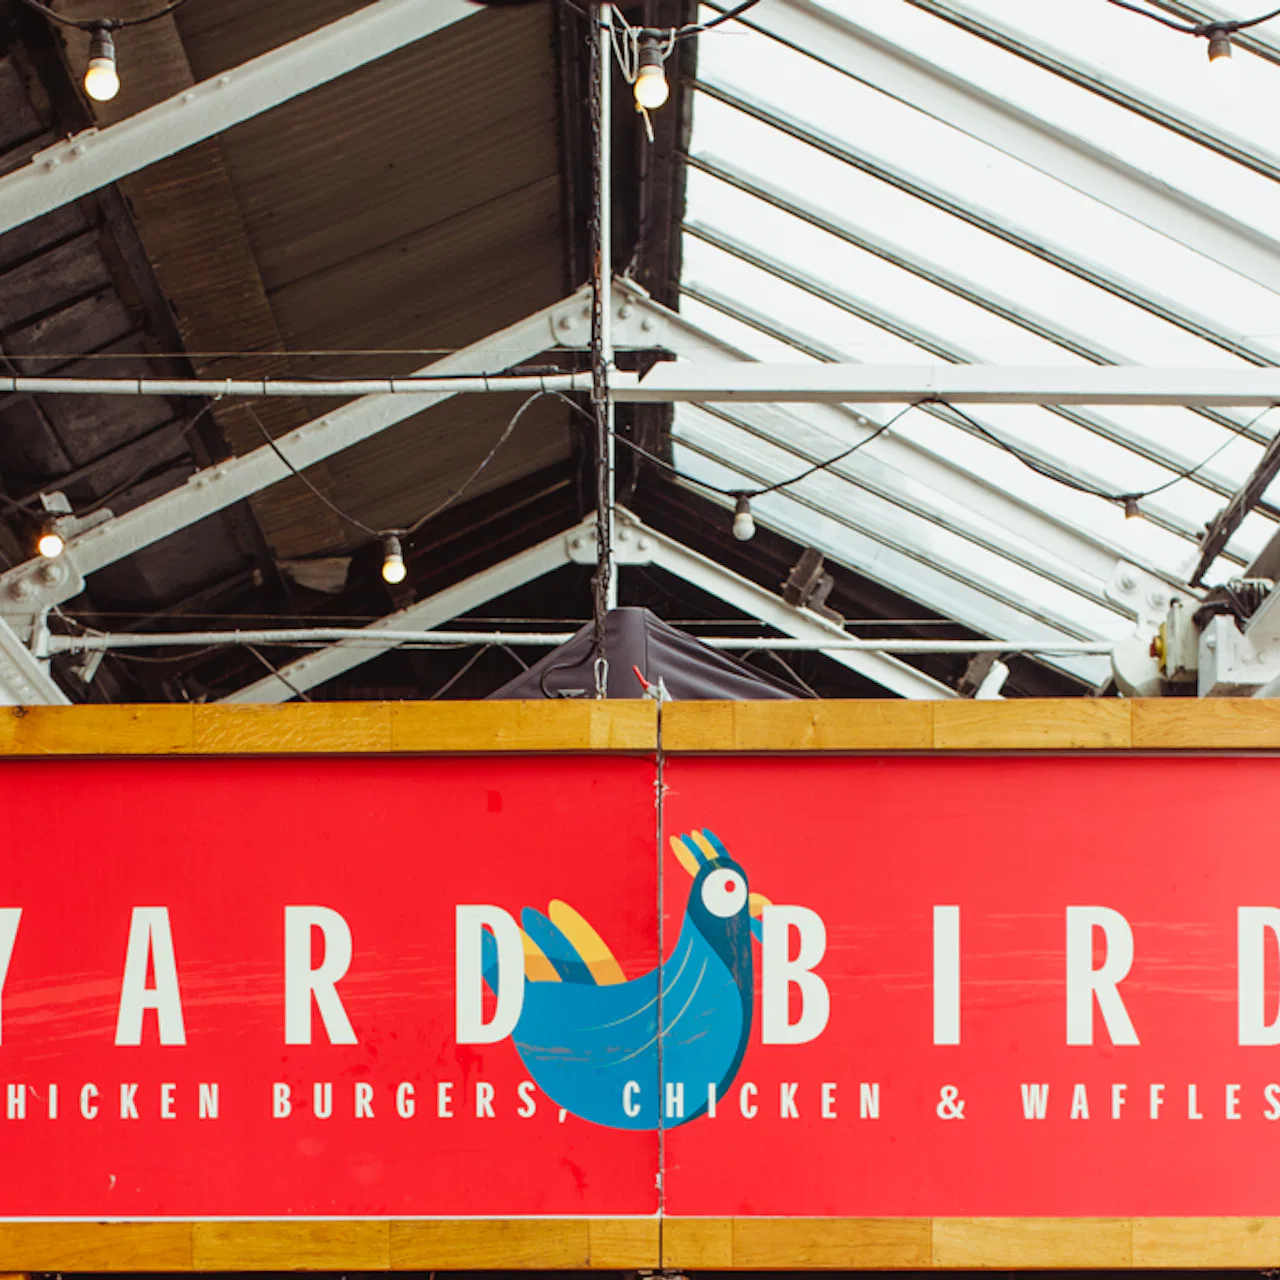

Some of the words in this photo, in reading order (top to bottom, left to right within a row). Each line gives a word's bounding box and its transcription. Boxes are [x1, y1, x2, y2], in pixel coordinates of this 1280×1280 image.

[274, 1082, 569, 1124] BURGERS,
[622, 1080, 880, 1120] CHICKEN
[936, 1085, 965, 1119] &
